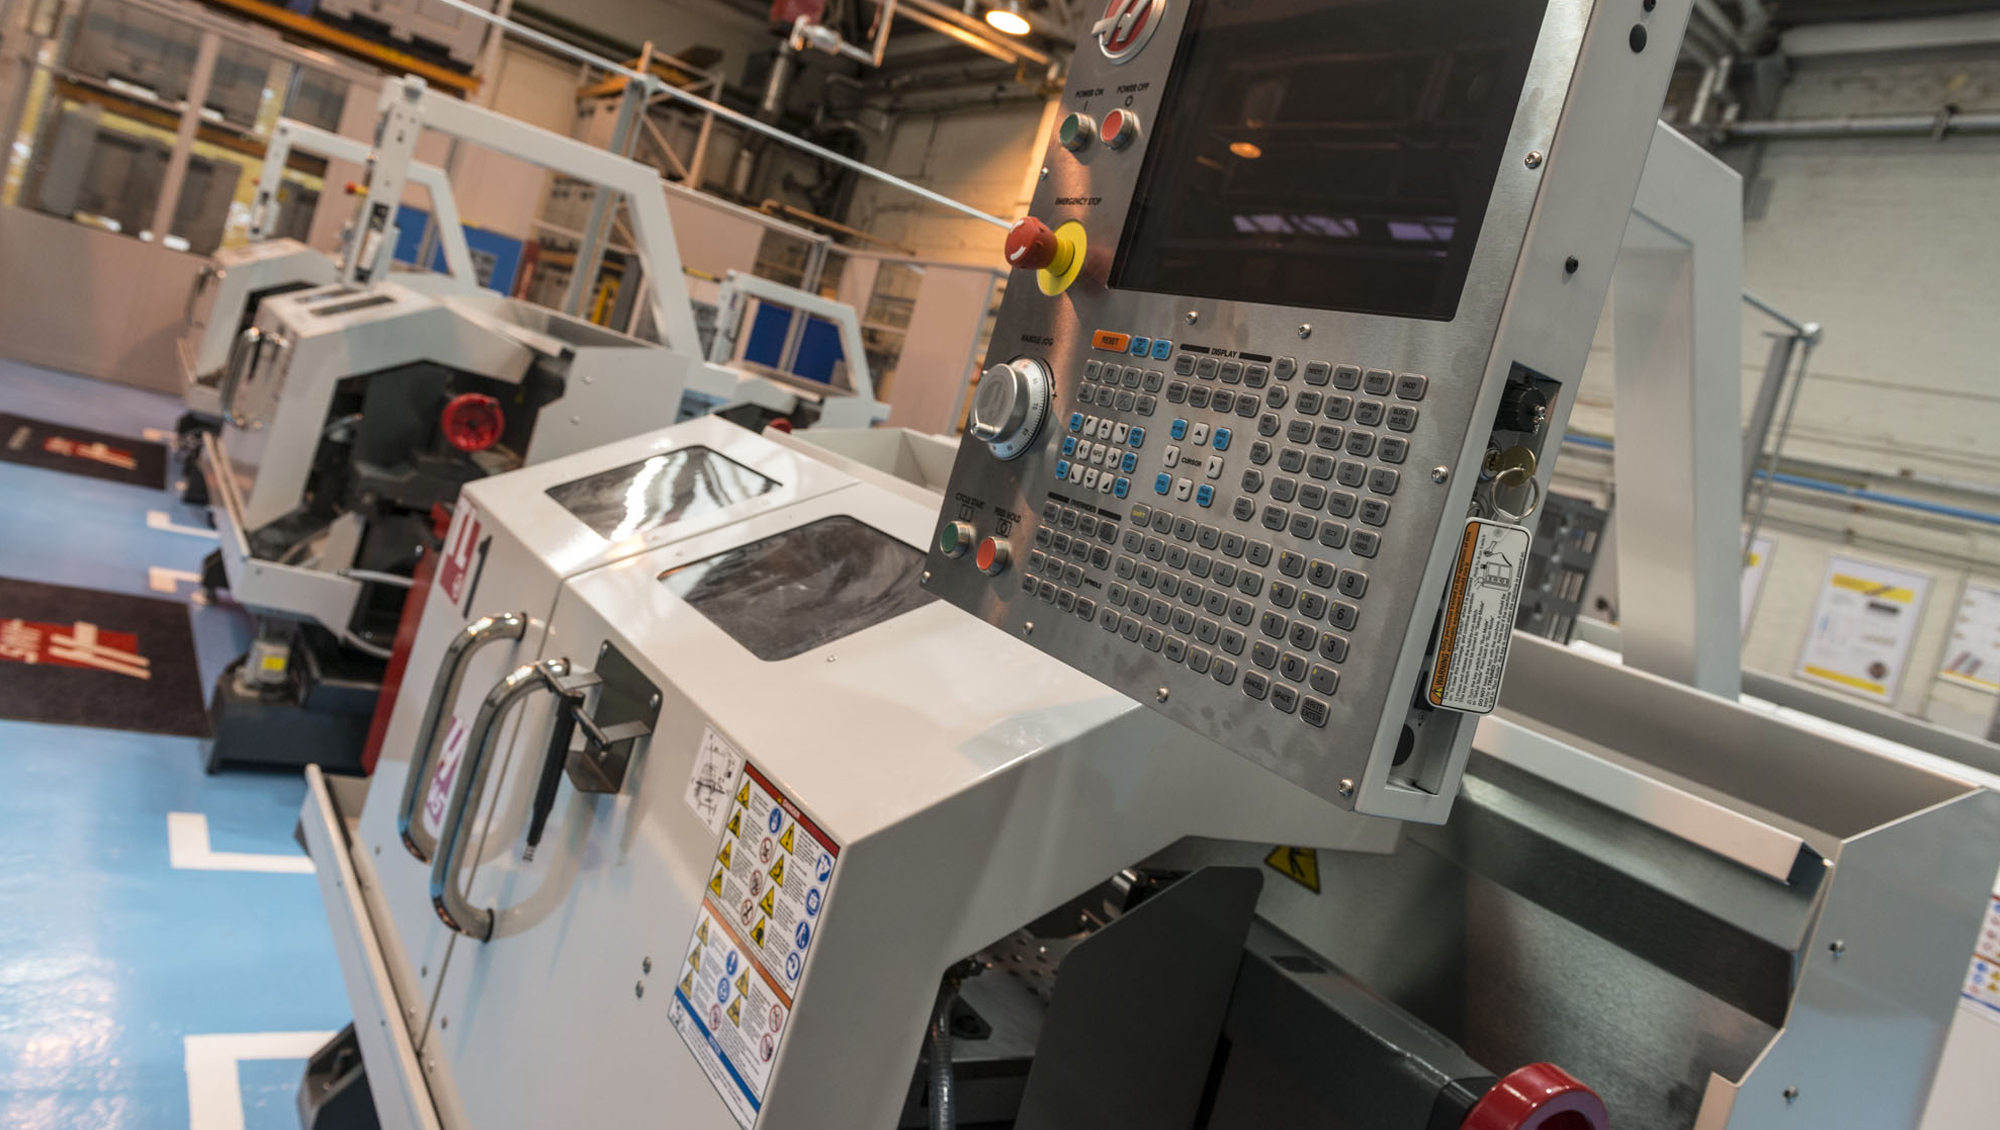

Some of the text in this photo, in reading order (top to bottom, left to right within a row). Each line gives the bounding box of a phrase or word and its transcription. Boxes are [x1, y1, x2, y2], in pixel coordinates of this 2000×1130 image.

[1116, 82, 1150, 94] POWER OFF
[1055, 197, 1102, 206] EMERGENCY STOP
[1041, 337, 1054, 347] JOG
[1101, 335, 1119, 345] RESET
[1211, 348, 1238, 358] DISPLAY
[1087, 365, 1095, 373] F1
[1107, 368, 1115, 377] F2
[1126, 372, 1135, 380] F3
[1147, 375, 1156, 384] F4
[1368, 377, 1384, 385] DELETE
[1402, 381, 1417, 390] UNDO
[1360, 403, 1378, 411] OPTION
[1393, 408, 1408, 416] BLOCK
[1320, 426, 1339, 436] SPINDLE
[1181, 457, 1202, 467] CURSOR
[1132, 509, 1146, 519] SHIFT
[1157, 517, 1164, 526] A
[1180, 524, 1186, 533] B
[1128, 536, 1134, 545] F
[1203, 531, 1210, 540] C
[1150, 543, 1156, 552] G
[1228, 539, 1235, 549] D
[1171, 551, 1178, 561] H
[1253, 546, 1260, 557] E
[1120, 562, 1126, 571] L
[1286, 556, 1295, 568] 7
[1140, 570, 1148, 579] M
[1219, 568, 1226, 577] J
[1315, 566, 1324, 579] 8
[1084, 577, 1102, 590] SPINDLE
[1162, 578, 1170, 588] N
[1244, 576, 1252, 586] K
[1346, 576, 1355, 589] 9
[1112, 588, 1119, 597] R
[1186, 587, 1193, 597] O
[1276, 587, 1285, 599] 4
[1133, 597, 1140, 606] S
[1211, 596, 1218, 605] P
[1306, 597, 1314, 609] 5
[1155, 606, 1162, 615] T
[1235, 606, 1243, 616] Q
[1337, 608, 1346, 621] 6
[1104, 614, 1111, 624] X
[1178, 615, 1185, 624] U
[1125, 624, 1132, 633] Y
[1203, 625, 1210, 634] V
[1147, 633, 1154, 643] Z
[1226, 634, 1235, 645] W
[1296, 628, 1305, 642] 2
[1327, 640, 1335, 653] 3
[1287, 659, 1296, 672] 0
[1437, 654, 1449, 685] WARNING
[1244, 677, 1263, 692] CANCEL
[1274, 689, 1291, 703] SPACE
[1305, 700, 1325, 713] WRITE
[1301, 709, 1322, 723] ENTER
